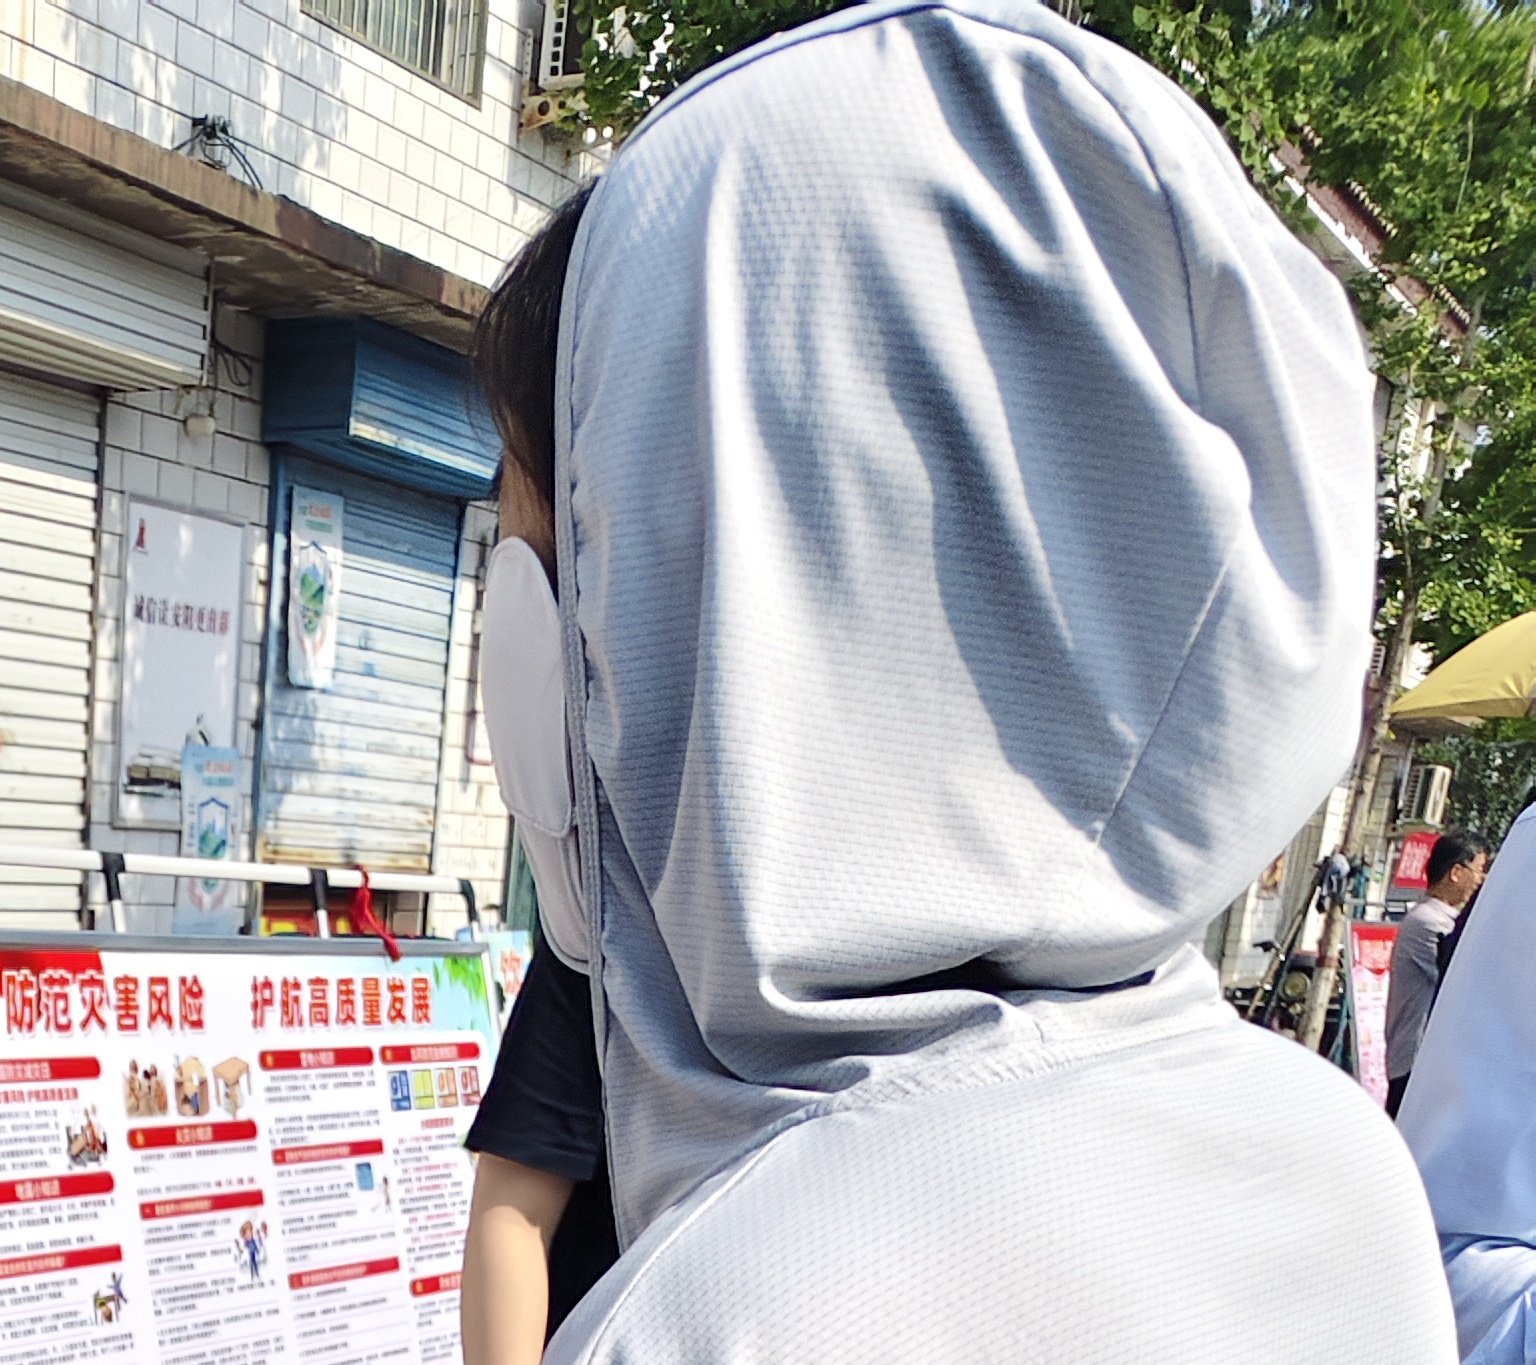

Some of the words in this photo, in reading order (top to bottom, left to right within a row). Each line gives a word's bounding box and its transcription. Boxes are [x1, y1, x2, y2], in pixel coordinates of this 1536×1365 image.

[3, 970, 205, 1035] 防范灾害风险
[250, 976, 432, 1029] 护航高质量发展
